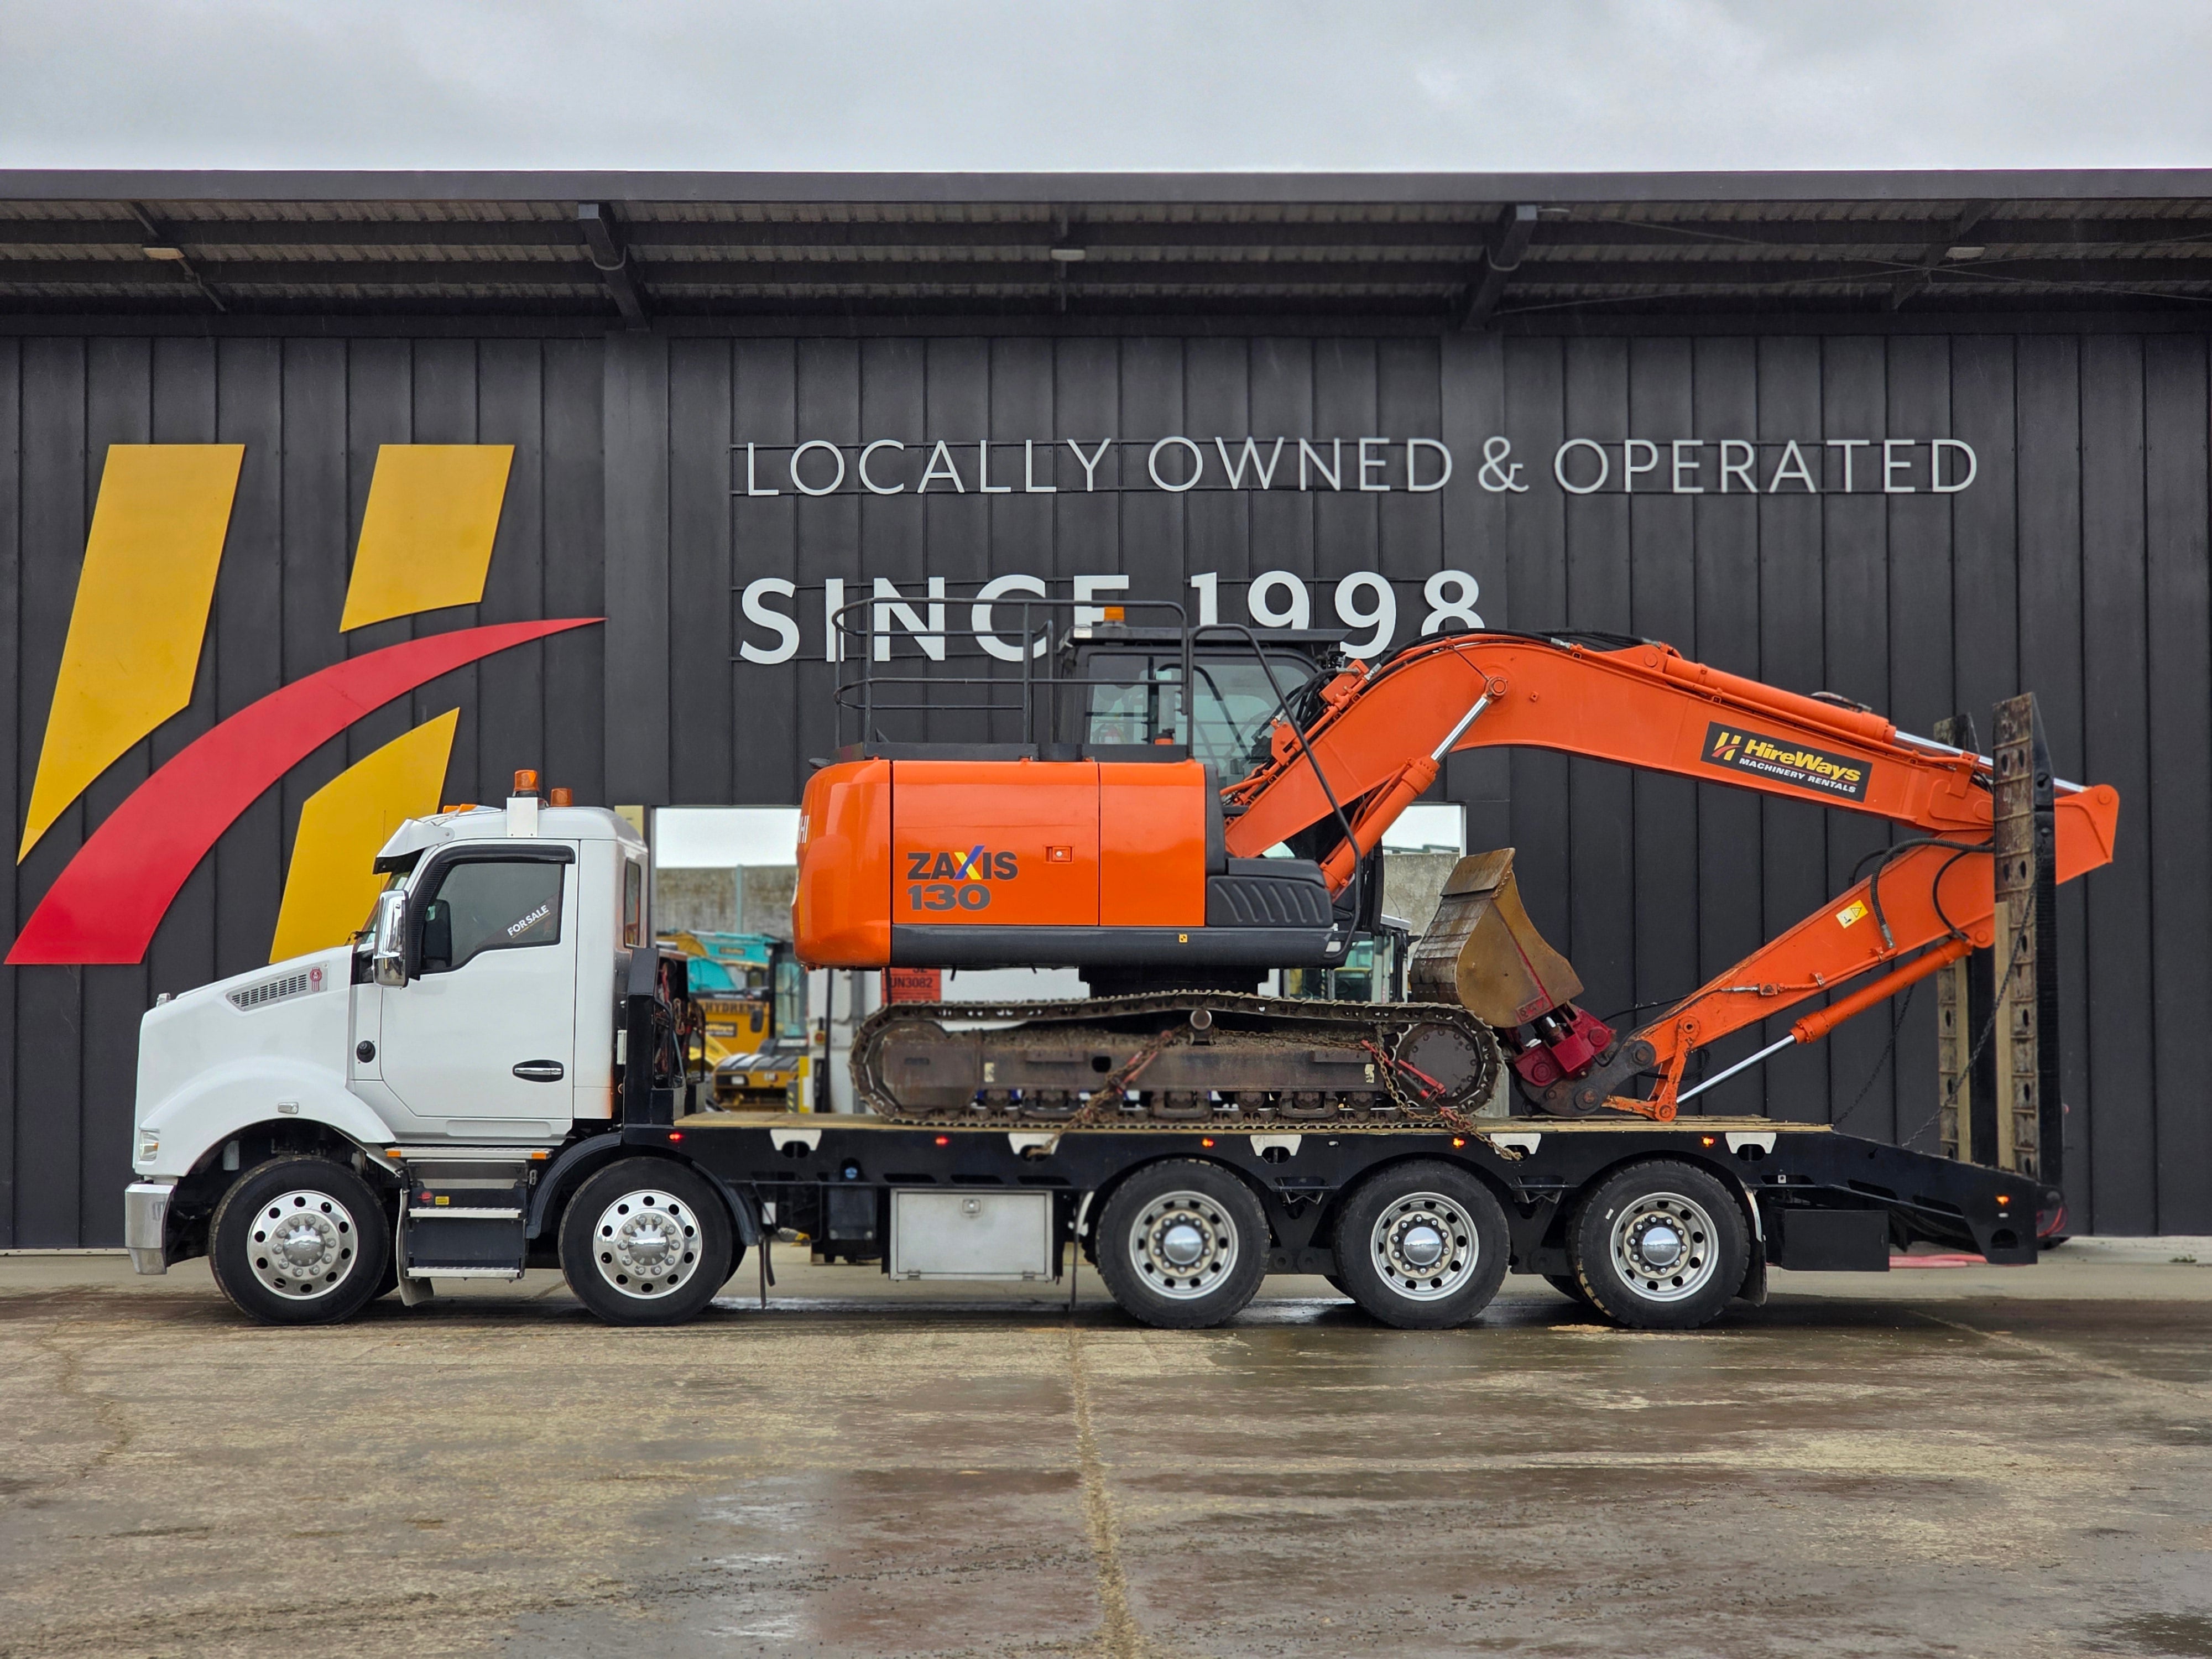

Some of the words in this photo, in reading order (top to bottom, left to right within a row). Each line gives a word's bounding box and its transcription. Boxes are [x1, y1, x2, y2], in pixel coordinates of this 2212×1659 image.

[747, 438, 1112, 496] LOCALLY
[1147, 436, 1453, 493] OWNED
[1478, 436, 1530, 493] &
[1554, 438, 1978, 494] OPERATED
[1739, 758, 1806, 780] MACHINERY
[1808, 776, 1856, 793] RENTALS
[1744, 738, 1862, 782] HireWays
[906, 845, 1019, 880] ZAXIS
[907, 885, 991, 911] 130
[507, 920, 528, 936] FOR
[525, 905, 549, 924] SALE
